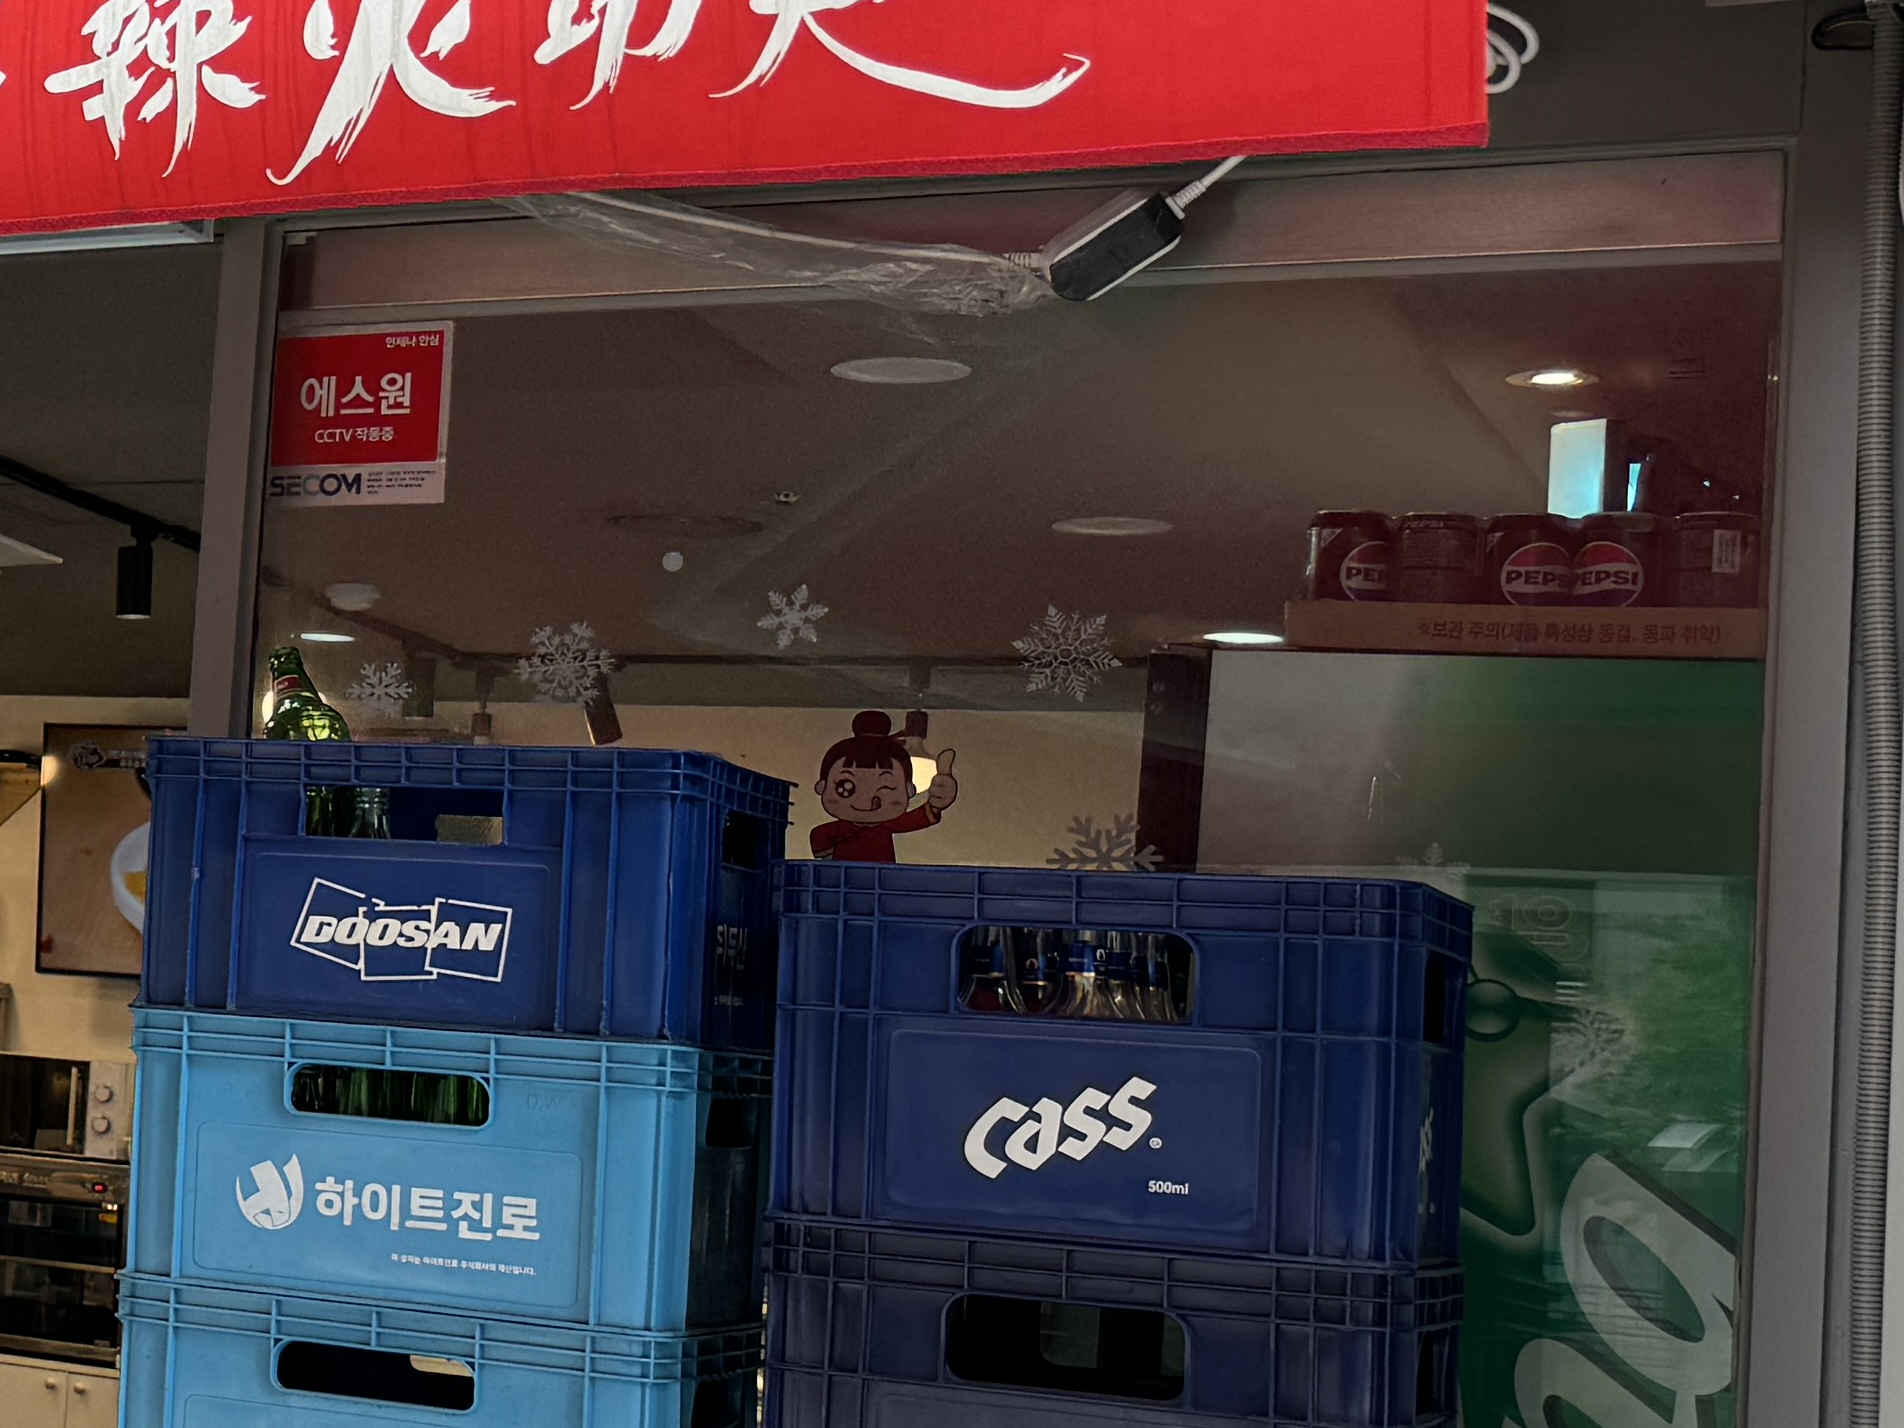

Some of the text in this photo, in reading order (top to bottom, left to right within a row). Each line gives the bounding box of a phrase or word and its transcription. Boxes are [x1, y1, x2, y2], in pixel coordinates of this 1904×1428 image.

[300, 372, 412, 417] 에스원
[314, 428, 351, 443] CCTV
[270, 473, 361, 496] SECOM
[1505, 570, 1570, 588] PEPS
[299, 915, 503, 952] DOOSAN
[964, 1076, 1158, 1178] Cass
[1147, 1179, 1190, 1196] 500ml
[315, 1176, 540, 1241] 하이트진로
